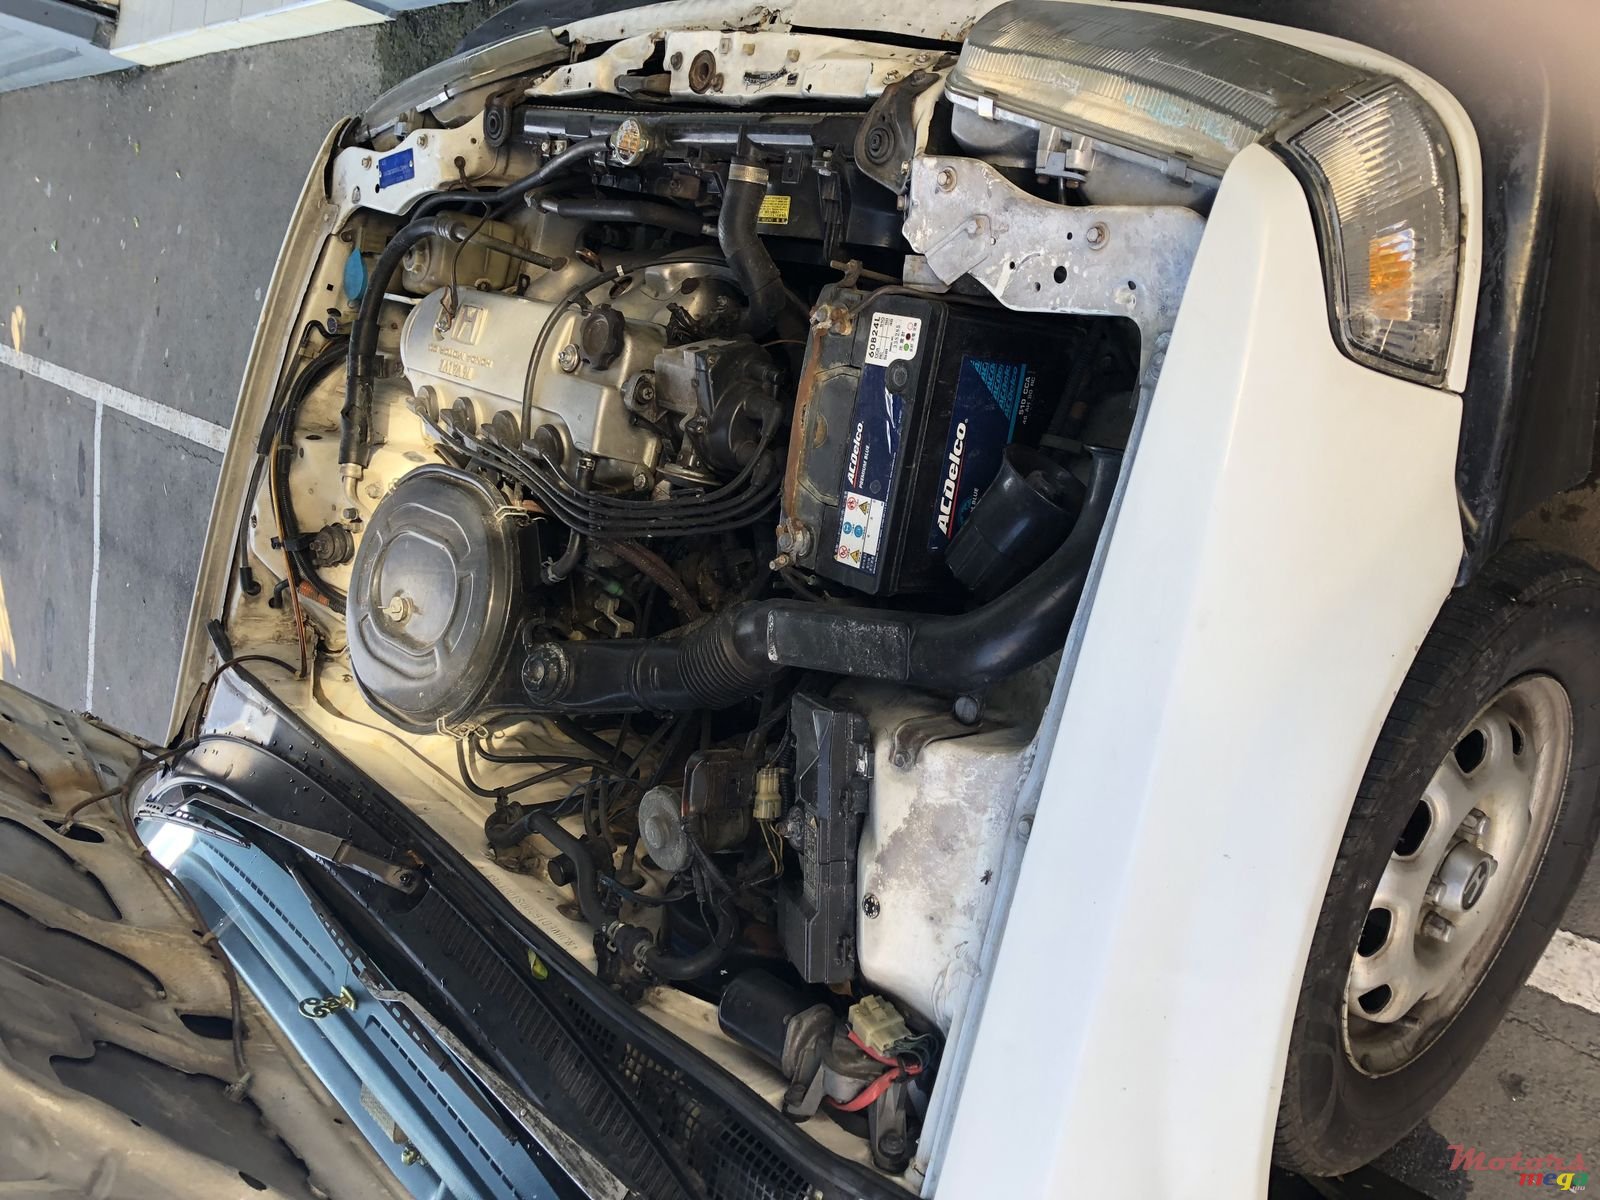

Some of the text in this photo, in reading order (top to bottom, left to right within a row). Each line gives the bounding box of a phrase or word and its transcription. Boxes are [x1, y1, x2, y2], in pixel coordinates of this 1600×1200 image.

[868, 316, 881, 358] 60B24L
[1022, 376, 1031, 395] CCA
[847, 422, 863, 486] ACDelco
[858, 461, 868, 489] PREMIUM
[937, 422, 967, 535] ACDelco
